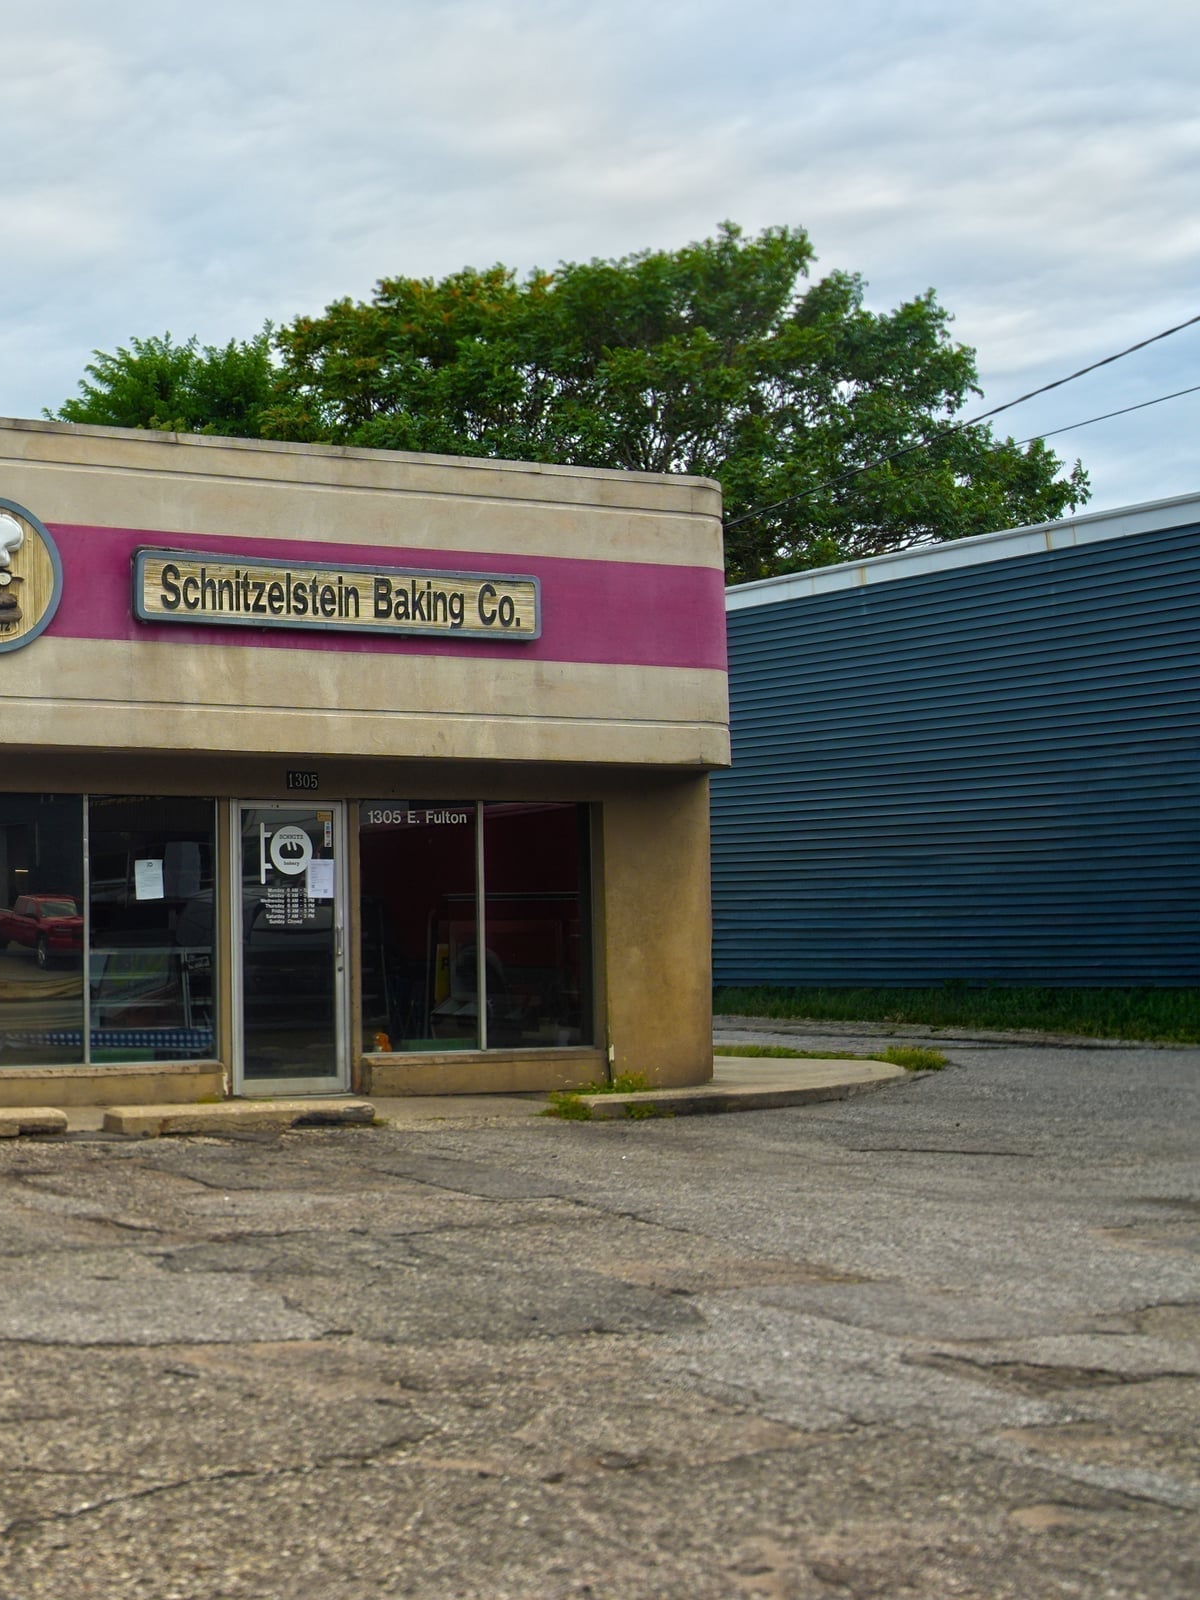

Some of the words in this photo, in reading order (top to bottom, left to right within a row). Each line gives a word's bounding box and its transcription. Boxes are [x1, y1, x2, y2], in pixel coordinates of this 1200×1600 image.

[160, 563, 360, 618] Schnitzelstein
[373, 577, 465, 629] Baking
[477, 582, 521, 627] Co.
[288, 773, 318, 789] 1305
[367, 810, 401, 824] 1305
[407, 810, 420, 824] E.
[425, 810, 467, 824] Fulton
